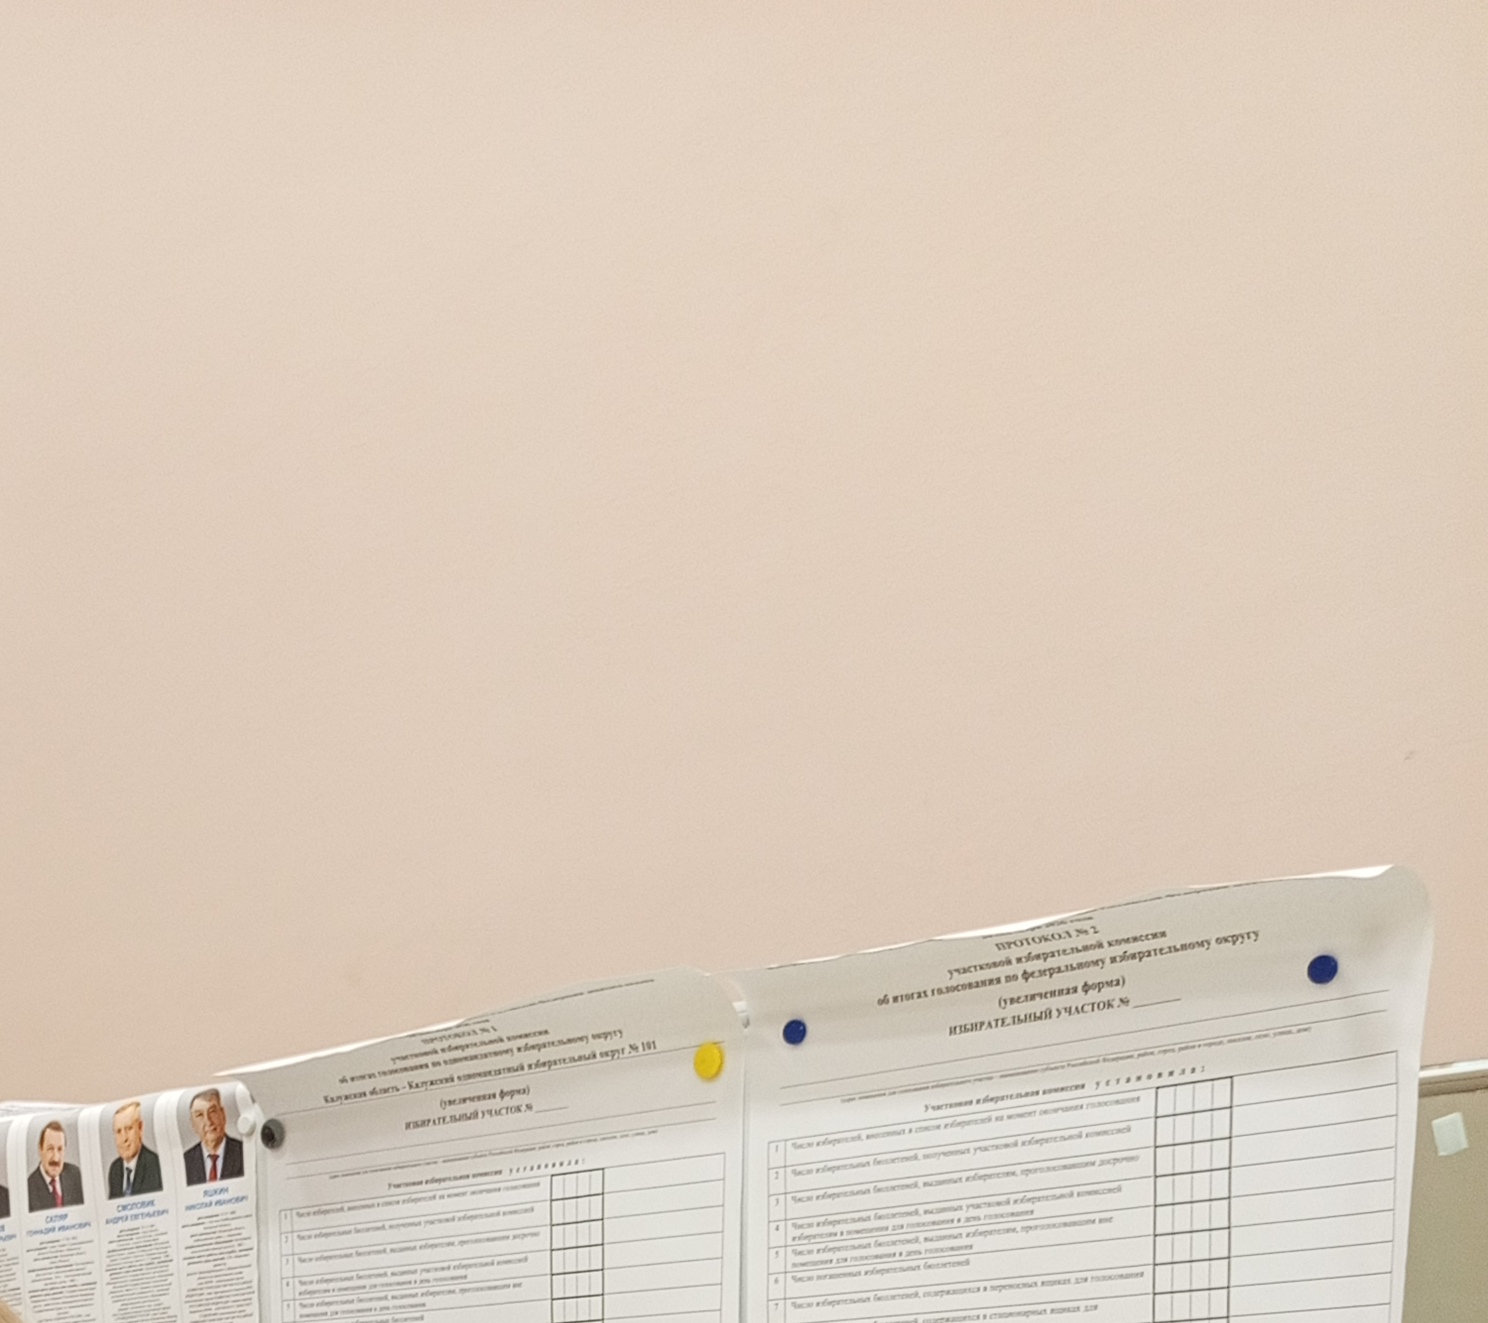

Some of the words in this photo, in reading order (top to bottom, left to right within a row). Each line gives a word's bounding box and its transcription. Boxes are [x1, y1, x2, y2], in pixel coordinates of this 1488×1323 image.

[877, 992, 890, 1005] об
[891, 989, 928, 1002] итогах
[930, 977, 1002, 996] голосования
[1003, 974, 1019, 984] по
[1020, 959, 1105, 984] федеральному
[1109, 942, 1211, 966] избирательному
[1216, 933, 1260, 949] округу
[948, 956, 1013, 980] участковой
[1015, 940, 1104, 965] избирательной
[1107, 931, 1167, 949] комиссии
[998, 987, 1078, 1010] (увеличенная
[1080, 977, 1126, 997] форма)
[948, 1008, 1052, 1035] ИЗБИРАТЕЛЬНЫЙ
[1055, 1000, 1114, 1019] УЧАСТОК
[1118, 998, 1130, 1010] №
[439, 1092, 497, 1109] (увеличенная
[498, 1084, 531, 1101] форма)
[404, 1109, 479, 1131] ИЗБИРАТЕЛЬНЫЙ
[480, 1104, 522, 1120] УЧАСТОК
[524, 1103, 533, 1114] №
